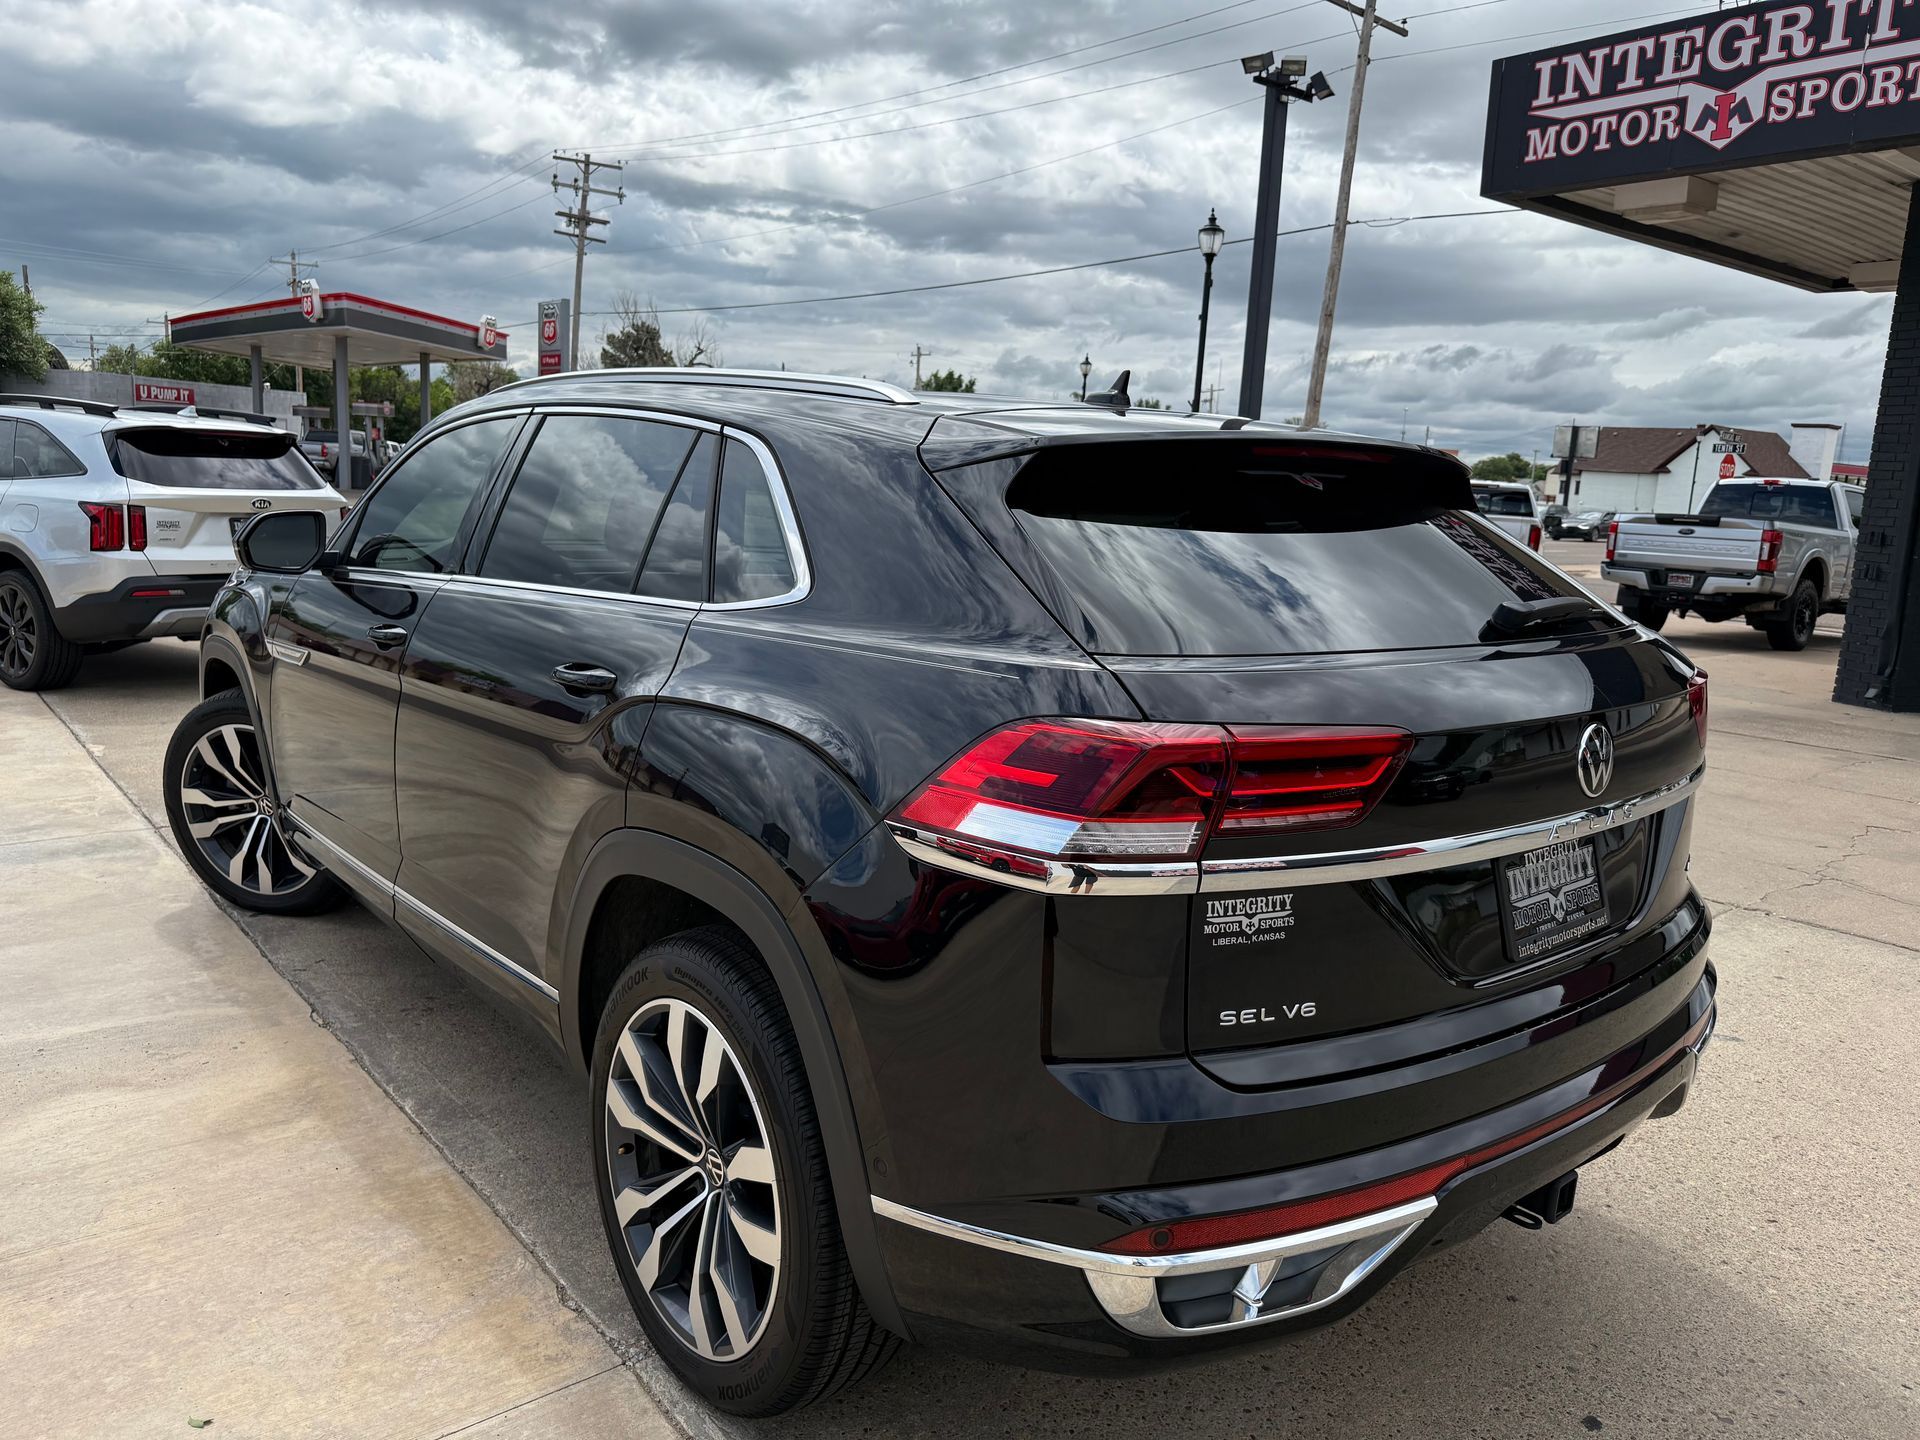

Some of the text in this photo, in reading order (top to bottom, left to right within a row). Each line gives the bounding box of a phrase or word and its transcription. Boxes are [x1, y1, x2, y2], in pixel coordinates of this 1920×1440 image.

[1531, 0, 1920, 108] INTEGRIT
[1524, 104, 1680, 163] MOTOR
[303, 296, 312, 313] 66
[486, 330, 496, 343] 66
[544, 322, 555, 338] 66
[140, 385, 190, 401] U PUMP IT
[1715, 444, 1743, 453] TENTH ST
[1720, 463, 1735, 476] STOP
[254, 499, 270, 509] KIA
[1548, 804, 1633, 840] ATLAS
[1524, 838, 1580, 866] INTEGRITY
[1506, 844, 1595, 901] INTEGRITY
[1206, 893, 1294, 918] INTEGRITY
[1512, 882, 1600, 930] MOTOR SPORTS
[1203, 917, 1295, 935] MOTOR SPORTS
[1518, 913, 1609, 958] integritymotorsports.net
[1212, 931, 1286, 946] LIBERAL, KANSAS
[1219, 1002, 1317, 1026] SEL V6
